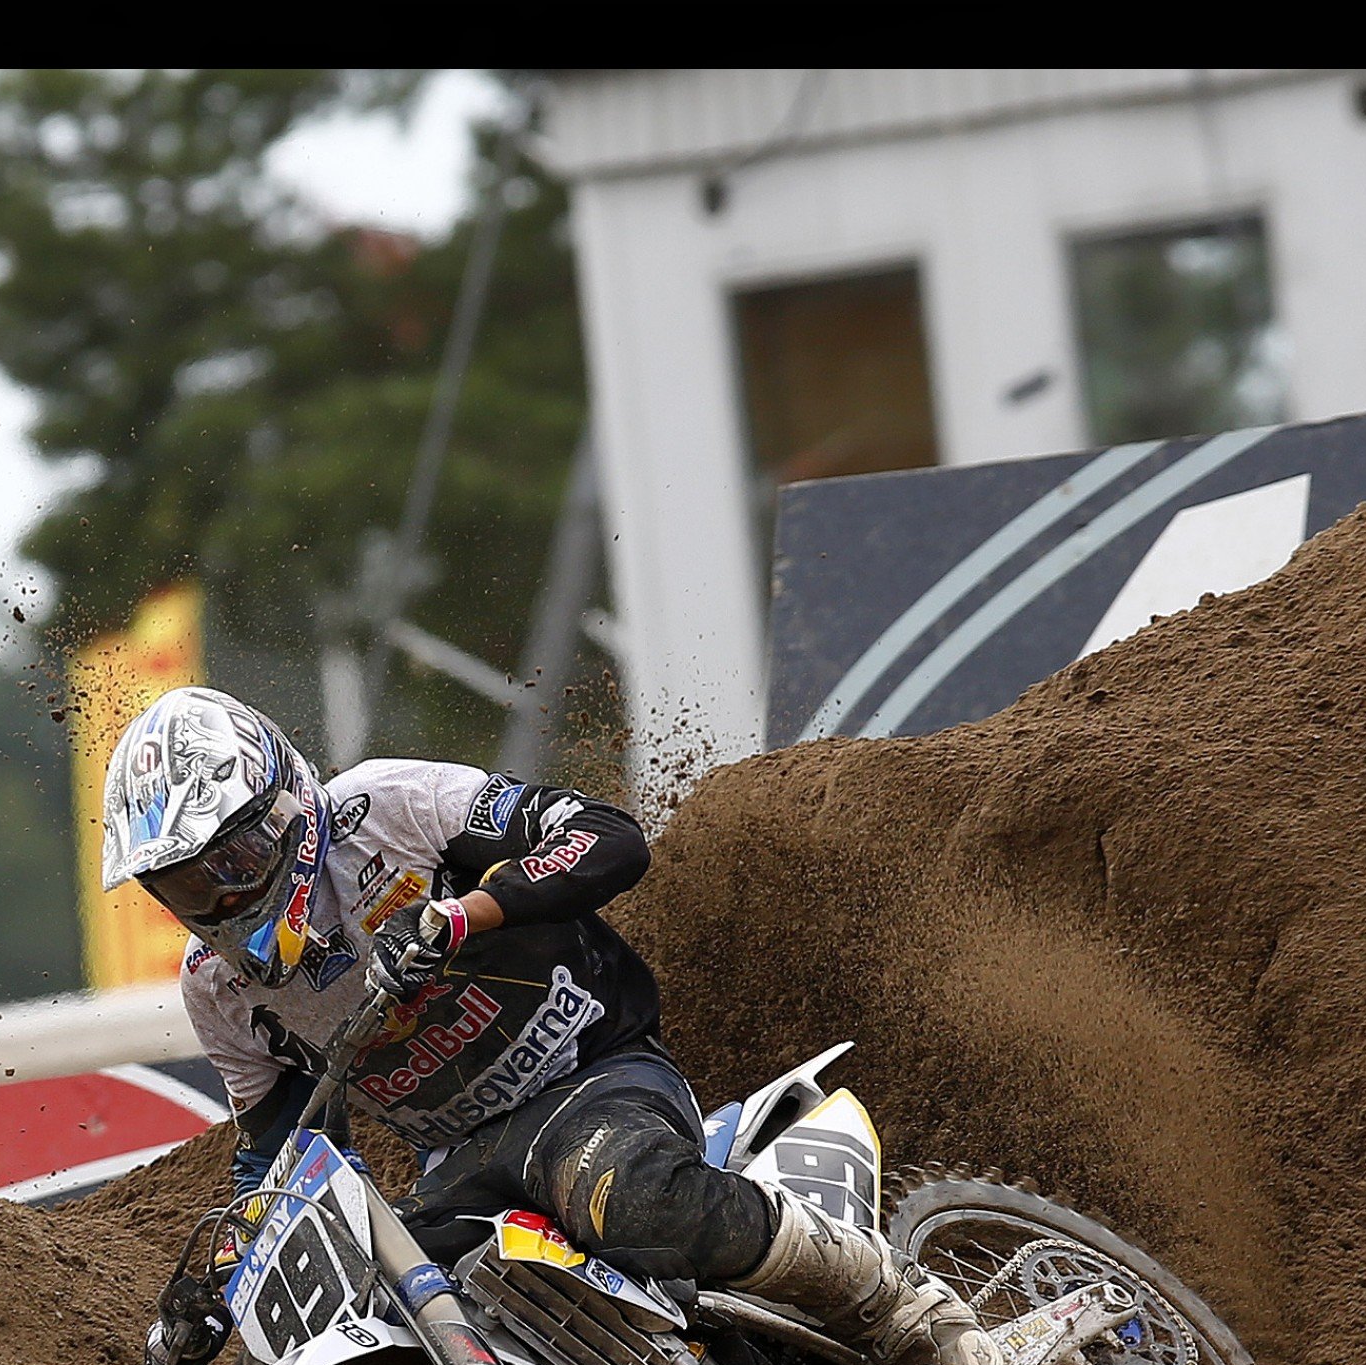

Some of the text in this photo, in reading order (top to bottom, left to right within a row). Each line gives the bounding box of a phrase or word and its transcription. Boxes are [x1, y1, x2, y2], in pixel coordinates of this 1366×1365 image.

[359, 984, 502, 1106] Red Bull
[407, 986, 584, 1137] Husqvarna
[254, 1216, 346, 1360] 99
